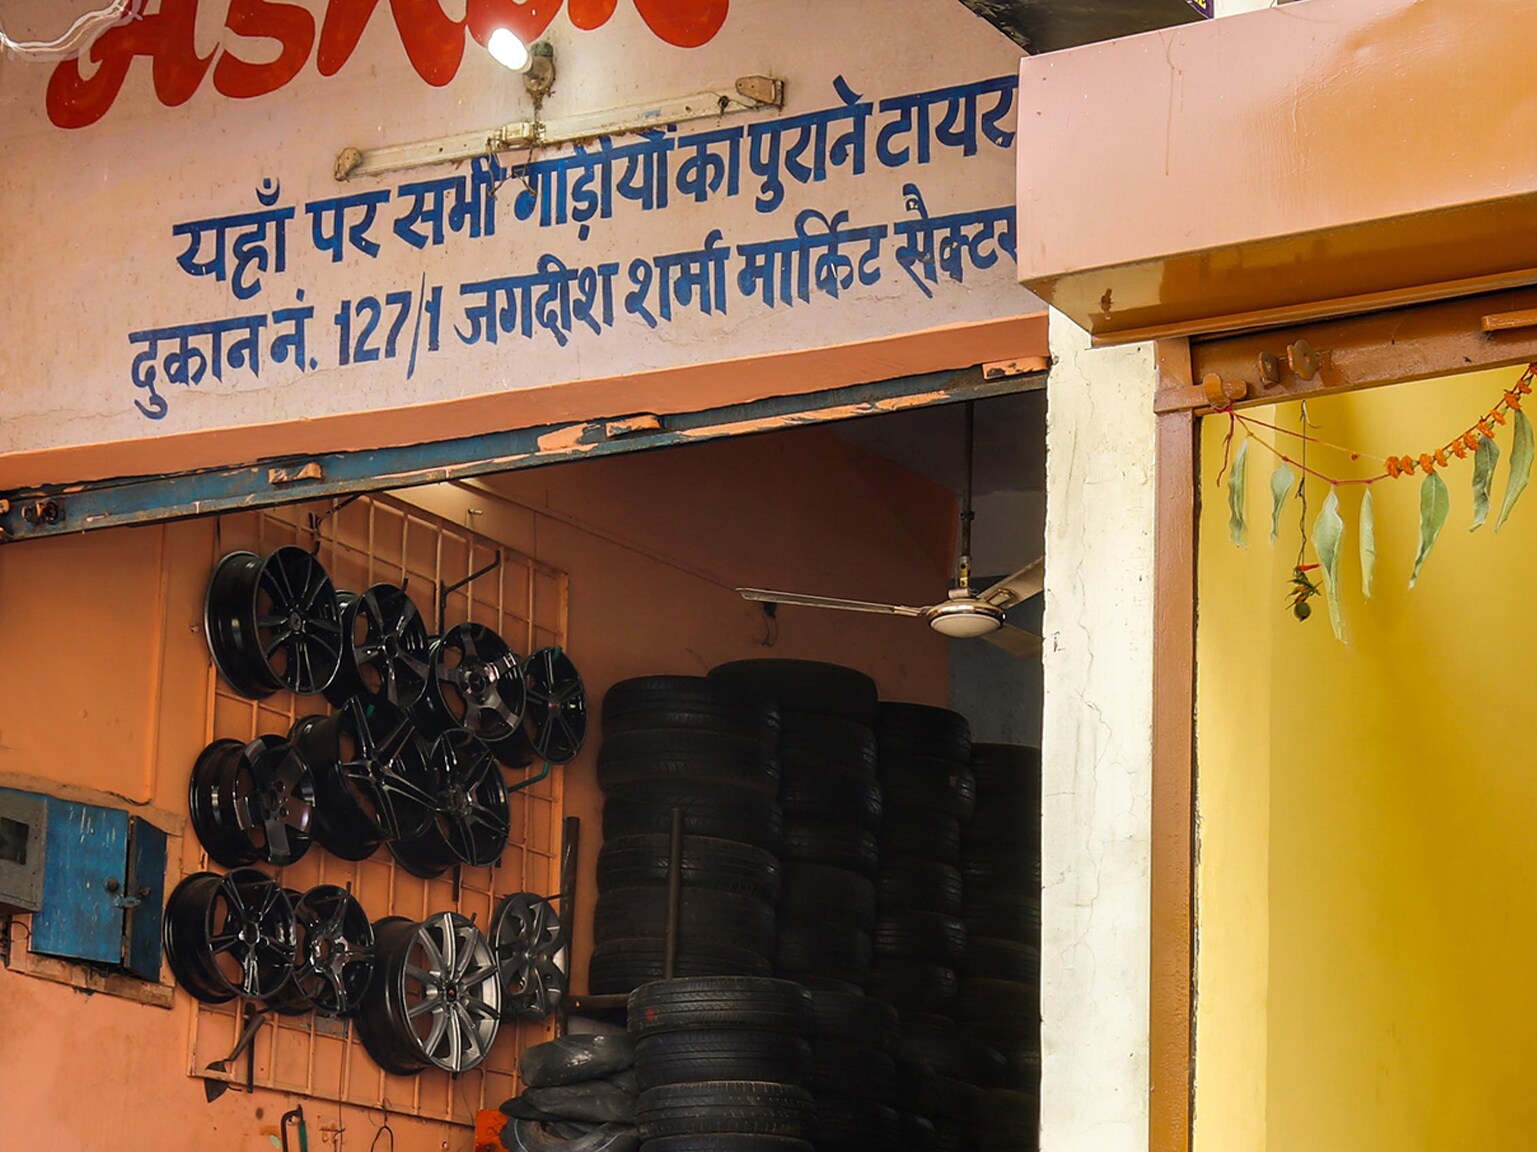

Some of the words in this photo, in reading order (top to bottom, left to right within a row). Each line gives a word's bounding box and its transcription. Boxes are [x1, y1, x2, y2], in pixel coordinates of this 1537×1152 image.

[172, 177, 296, 300] यहाँ
[304, 189, 391, 262] पर
[675, 125, 745, 202] का
[747, 74, 873, 213] पुराने
[876, 74, 1019, 168] टायर
[128, 314, 268, 420] दुकान
[334, 271, 443, 381] 127/1
[453, 253, 620, 347] जगदीश
[625, 229, 731, 329] शर्मा
